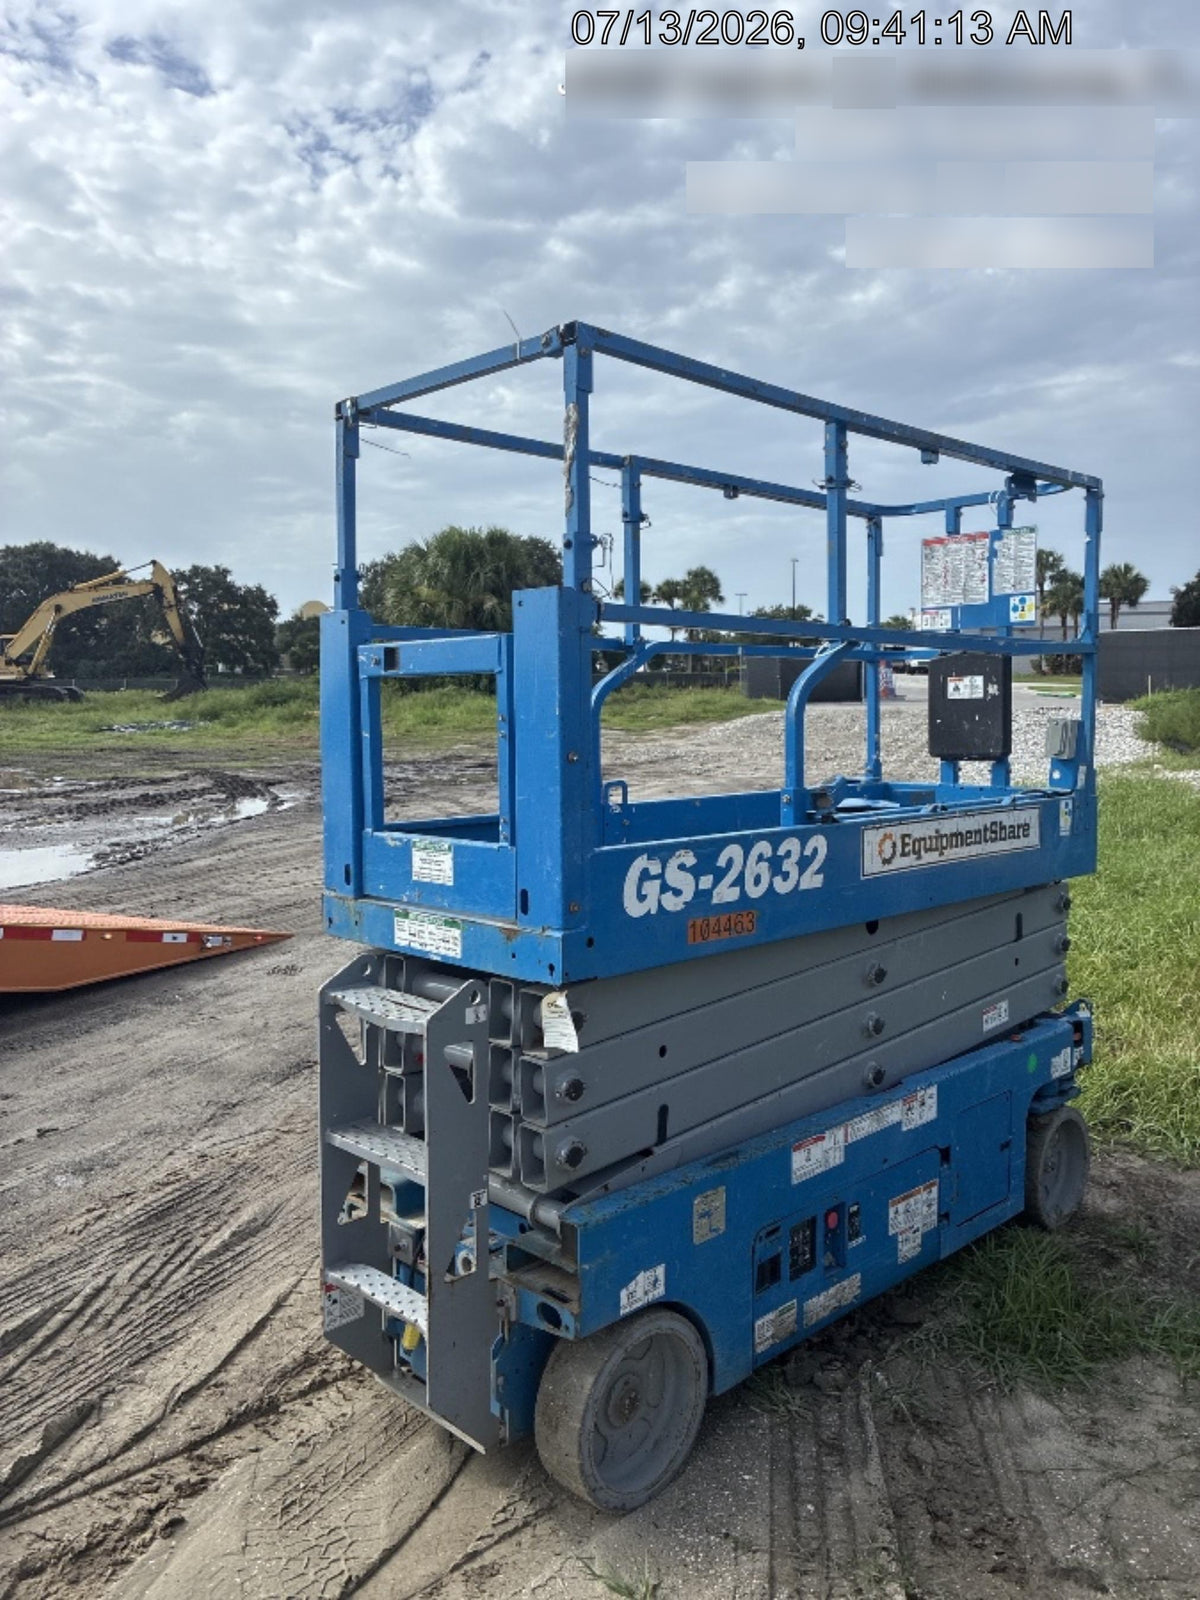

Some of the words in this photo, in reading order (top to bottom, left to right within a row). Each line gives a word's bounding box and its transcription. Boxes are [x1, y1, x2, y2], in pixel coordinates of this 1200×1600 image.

[899, 820, 1031, 860] EquipmentShare
[623, 834, 828, 918] GS-2632
[689, 911, 755, 943] 104463
